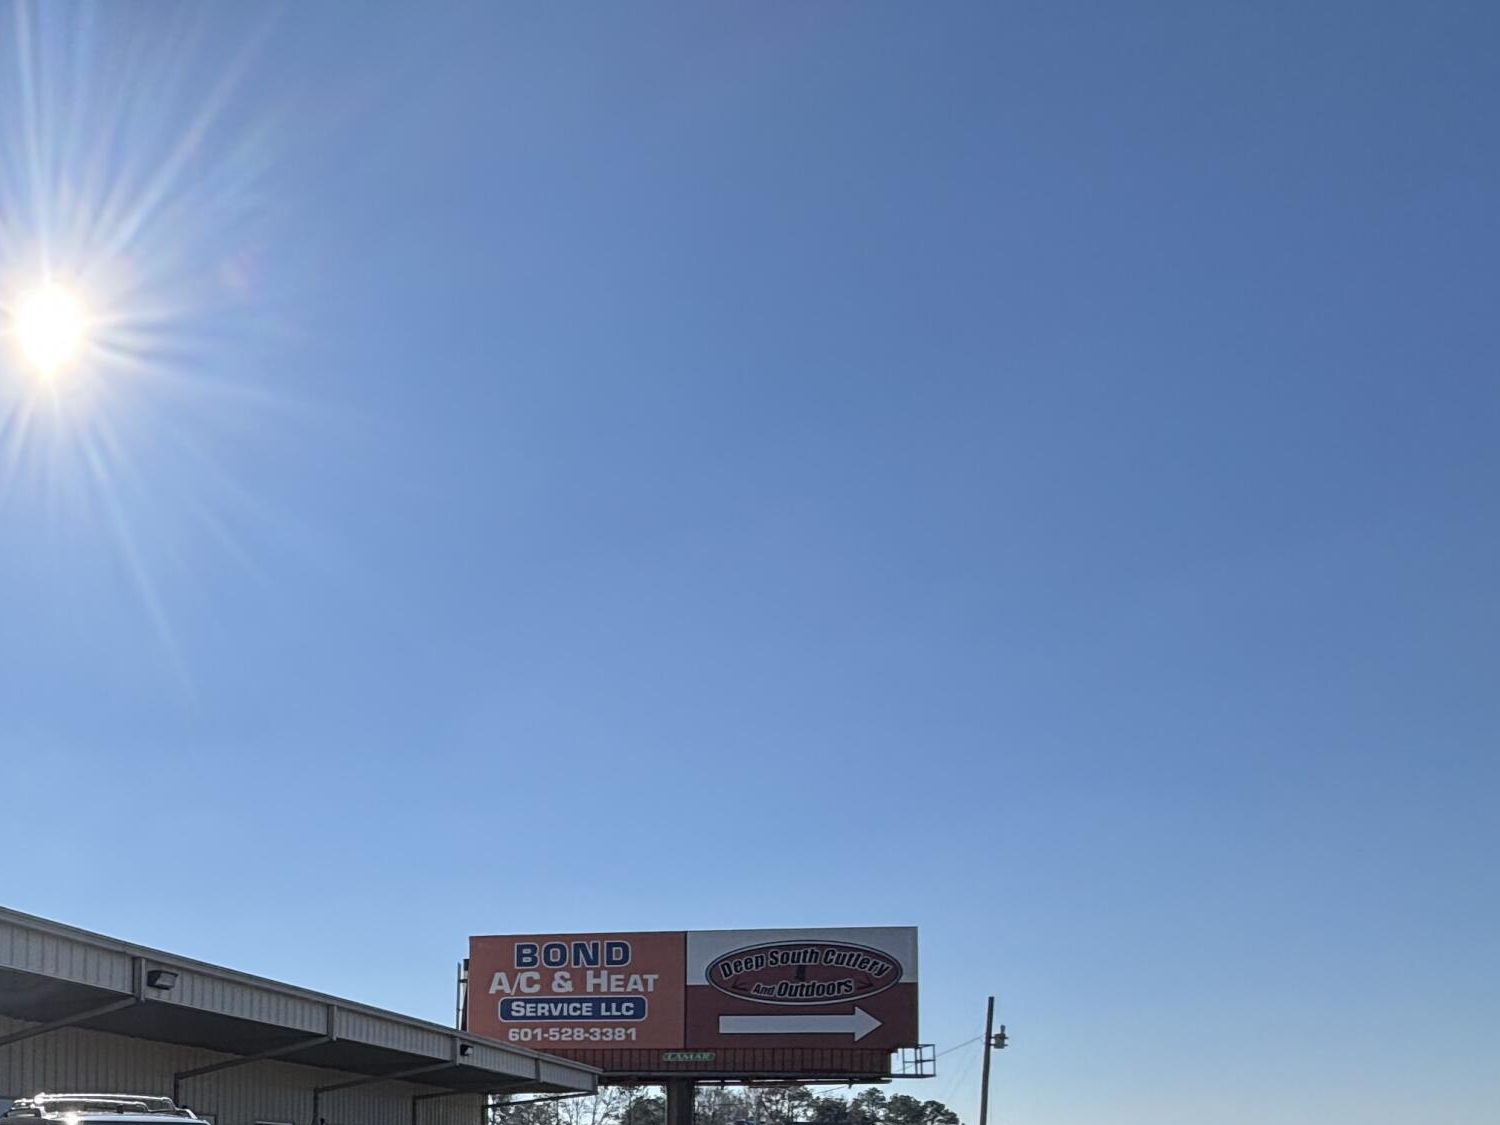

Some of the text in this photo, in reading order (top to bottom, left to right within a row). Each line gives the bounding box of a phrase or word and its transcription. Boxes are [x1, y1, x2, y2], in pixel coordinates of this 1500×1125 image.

[514, 940, 632, 969] BOND
[721, 948, 891, 980] Deep South Cutlery
[488, 970, 659, 995] A/C & HEAT
[753, 979, 853, 998] And Outdoors
[511, 1001, 635, 1017] SERVICE LLC
[508, 1027, 637, 1042] 601-528-3381
